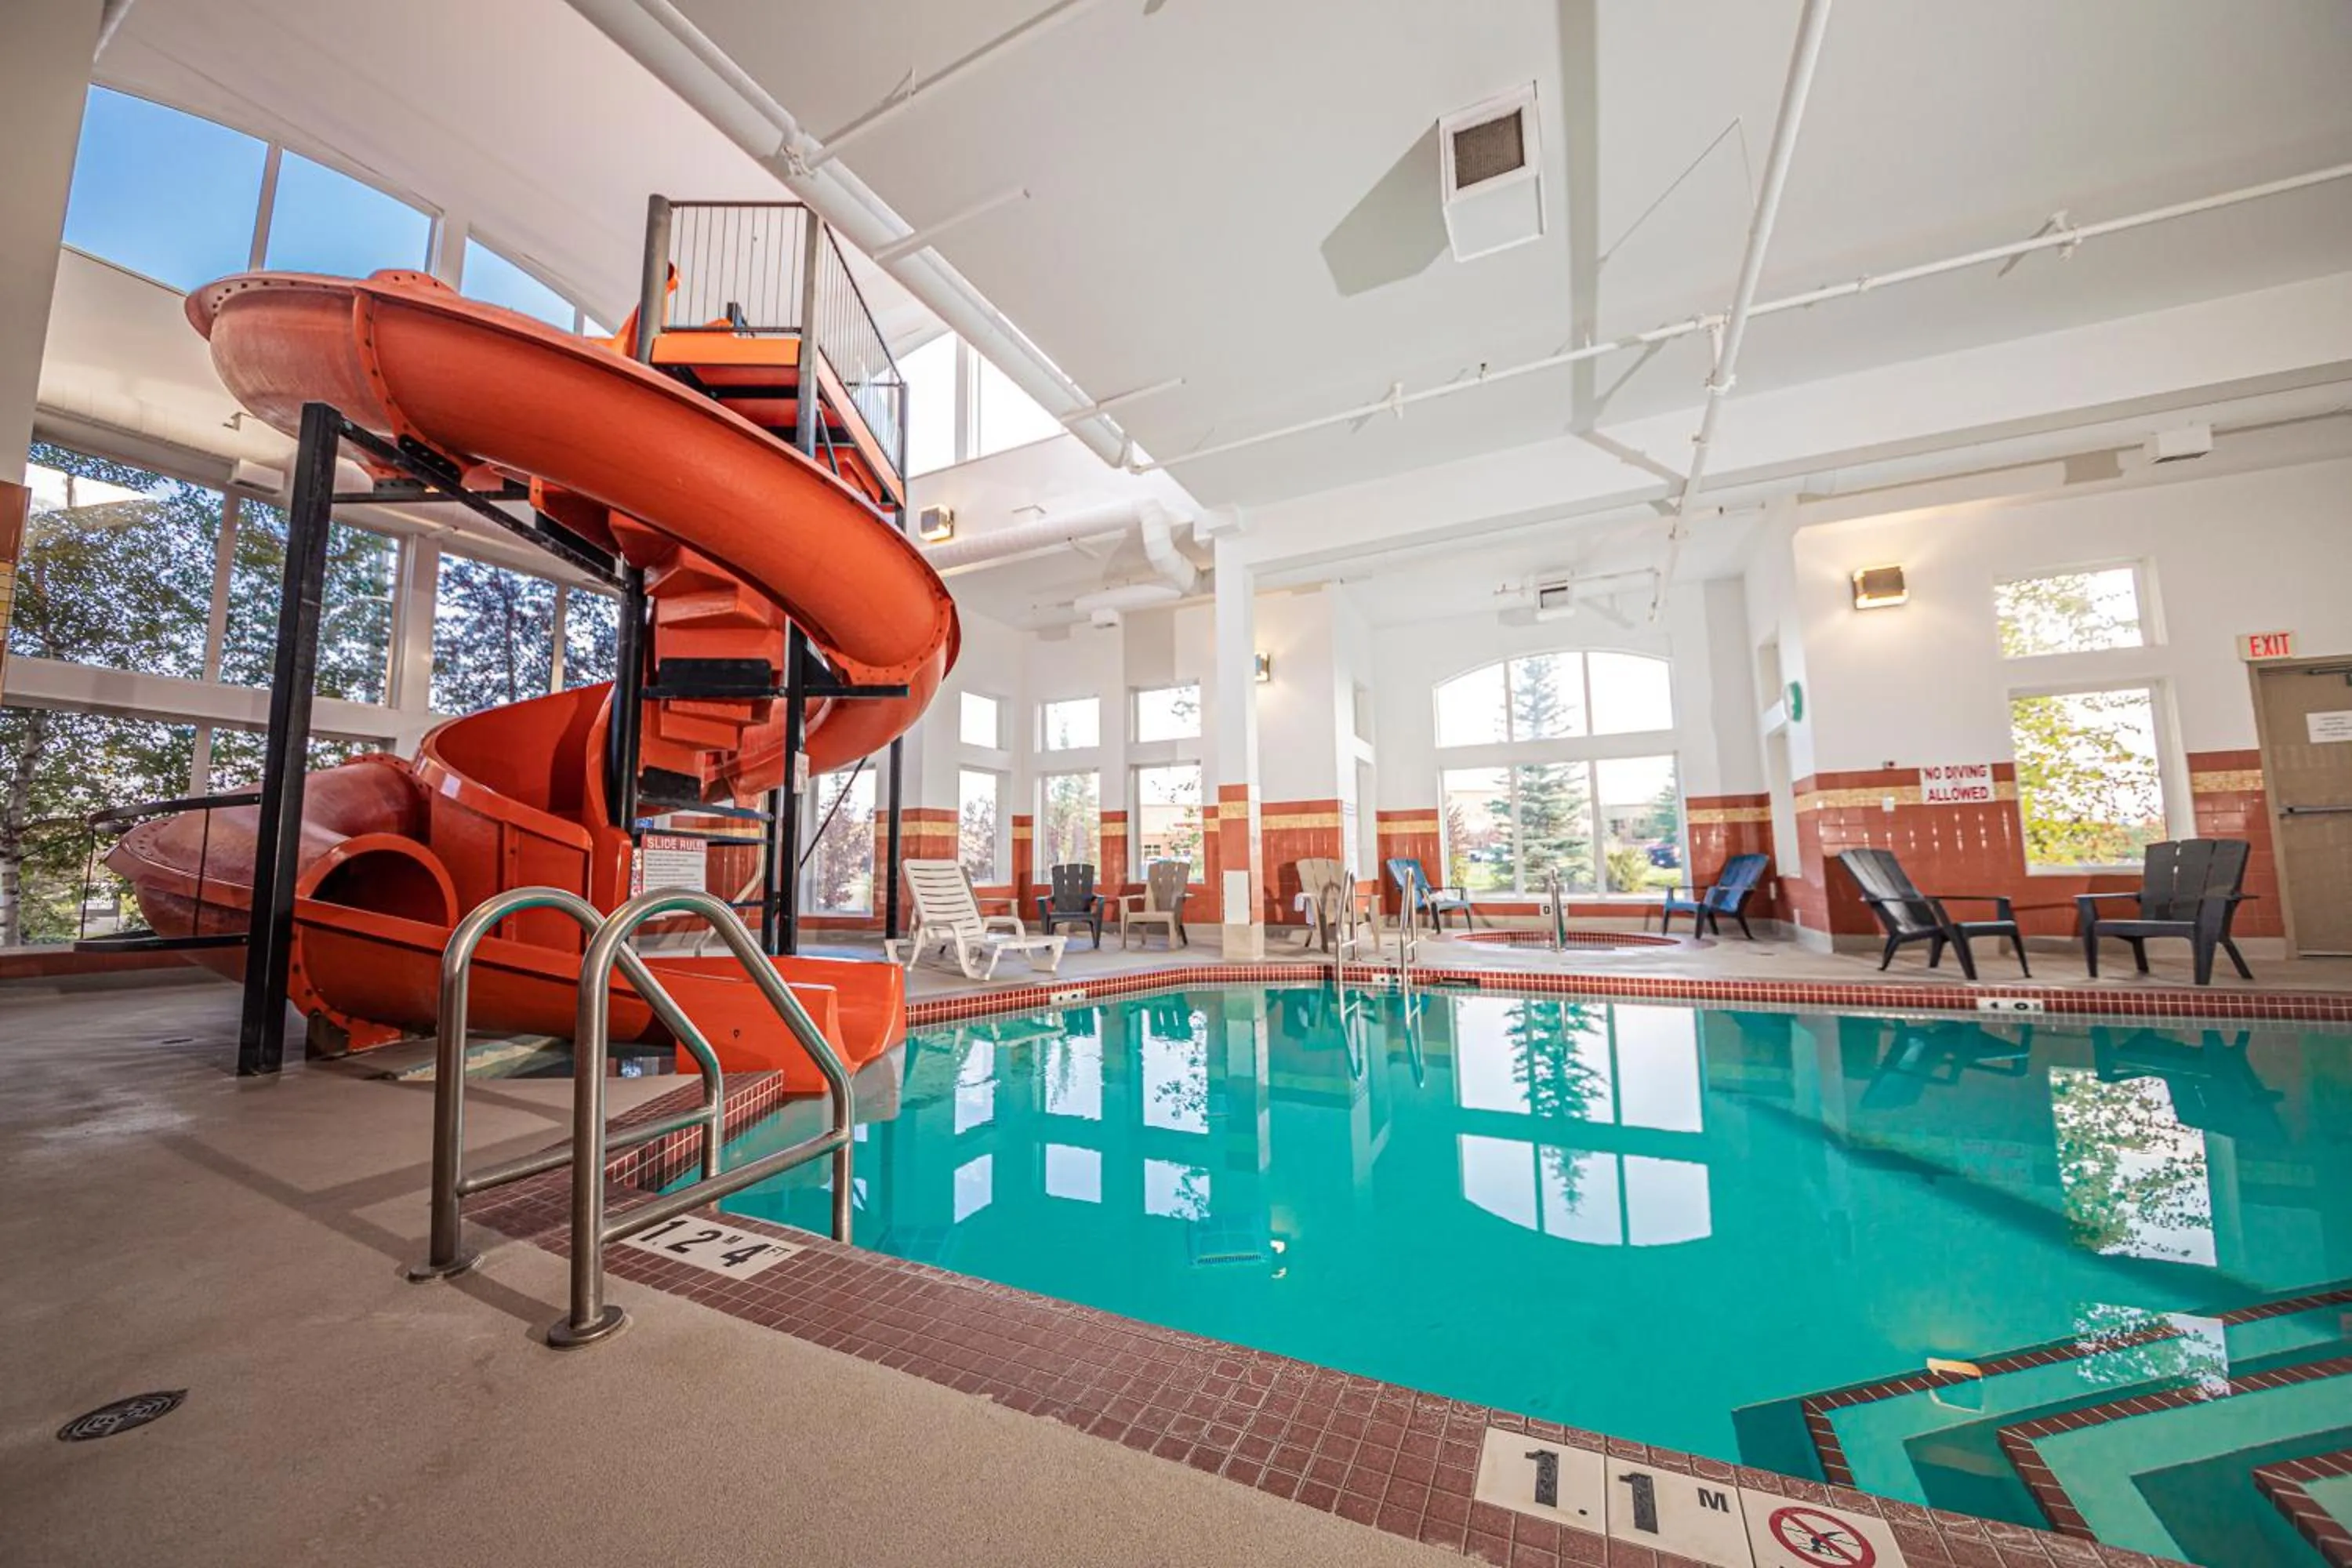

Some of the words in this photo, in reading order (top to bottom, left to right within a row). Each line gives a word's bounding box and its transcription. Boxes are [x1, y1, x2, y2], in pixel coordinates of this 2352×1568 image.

[2249, 633, 2289, 656] EXIT
[1925, 766, 1942, 779] NO
[1945, 764, 1987, 779] DIVING
[1929, 786, 1988, 800] ALLOWED
[719, 1243, 772, 1267] 4
[1697, 1487, 1730, 1514] M
